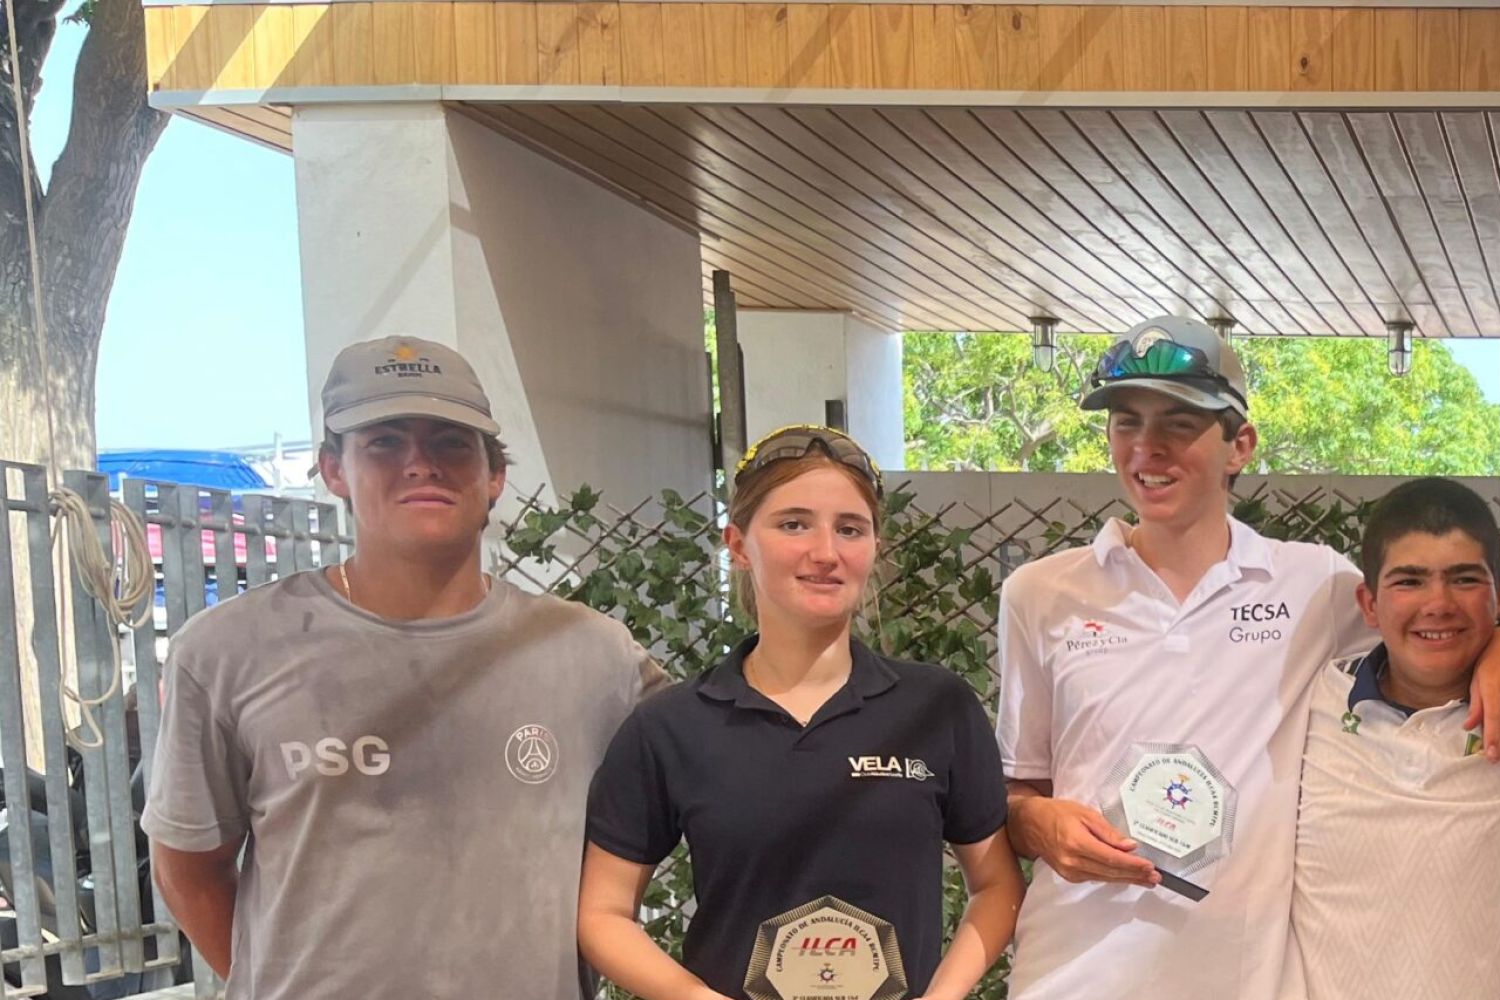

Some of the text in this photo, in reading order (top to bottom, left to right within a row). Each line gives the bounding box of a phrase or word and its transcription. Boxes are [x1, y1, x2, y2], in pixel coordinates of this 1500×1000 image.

[374, 363, 441, 374] ESTRELLA
[1229, 602, 1290, 622] TECSA
[1229, 626, 1282, 644] Grupo
[279, 735, 391, 781] PSG
[848, 756, 902, 772] VELA
[776, 927, 799, 973] CAMPEONATO
[799, 921, 809, 930] DE
[811, 916, 853, 927] ANDALUCÍA
[798, 938, 858, 956] ILCA
